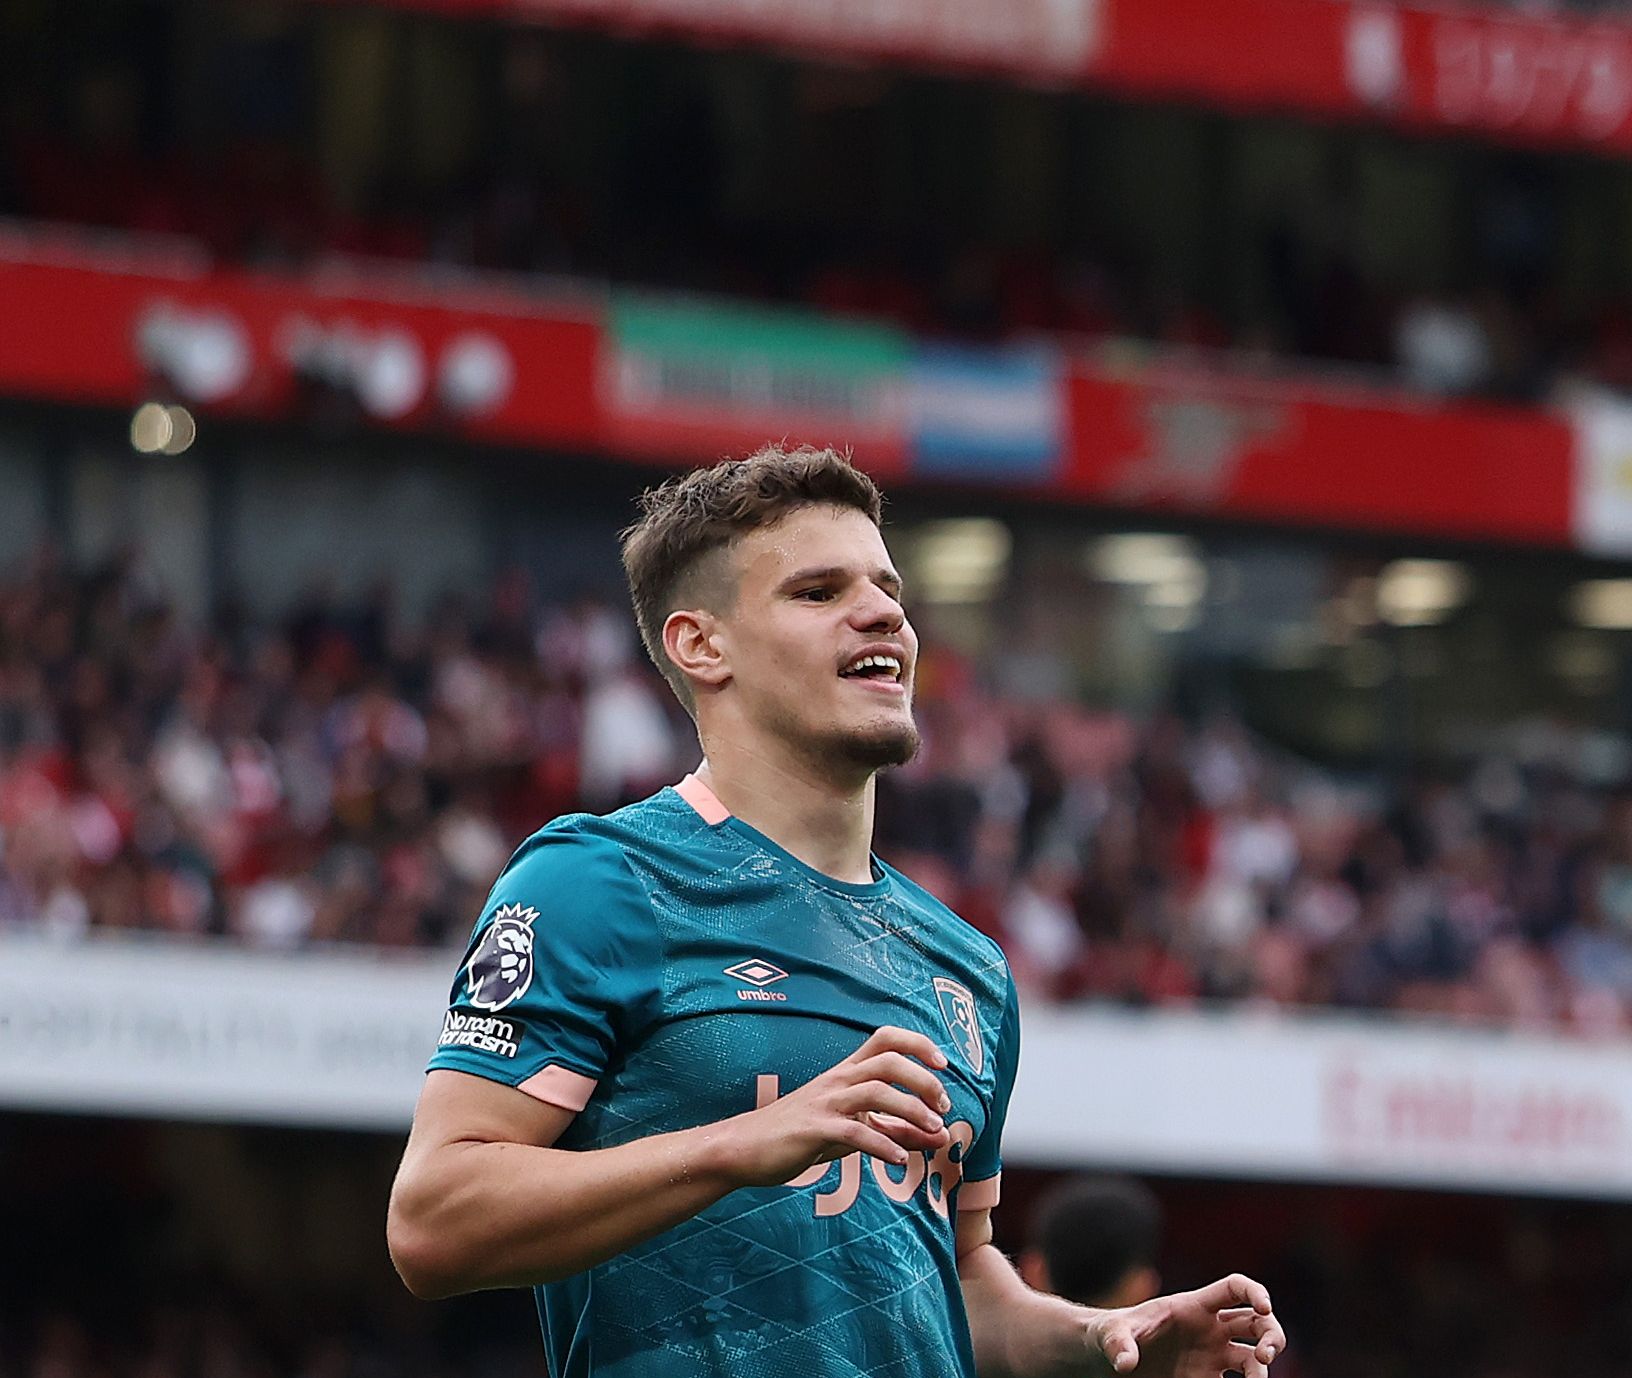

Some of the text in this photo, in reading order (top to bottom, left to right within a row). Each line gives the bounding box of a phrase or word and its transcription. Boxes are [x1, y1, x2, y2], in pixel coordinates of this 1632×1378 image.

[736, 988, 787, 1002] umbro
[444, 1010, 513, 1040] No room
[454, 1030, 518, 1058] racism
